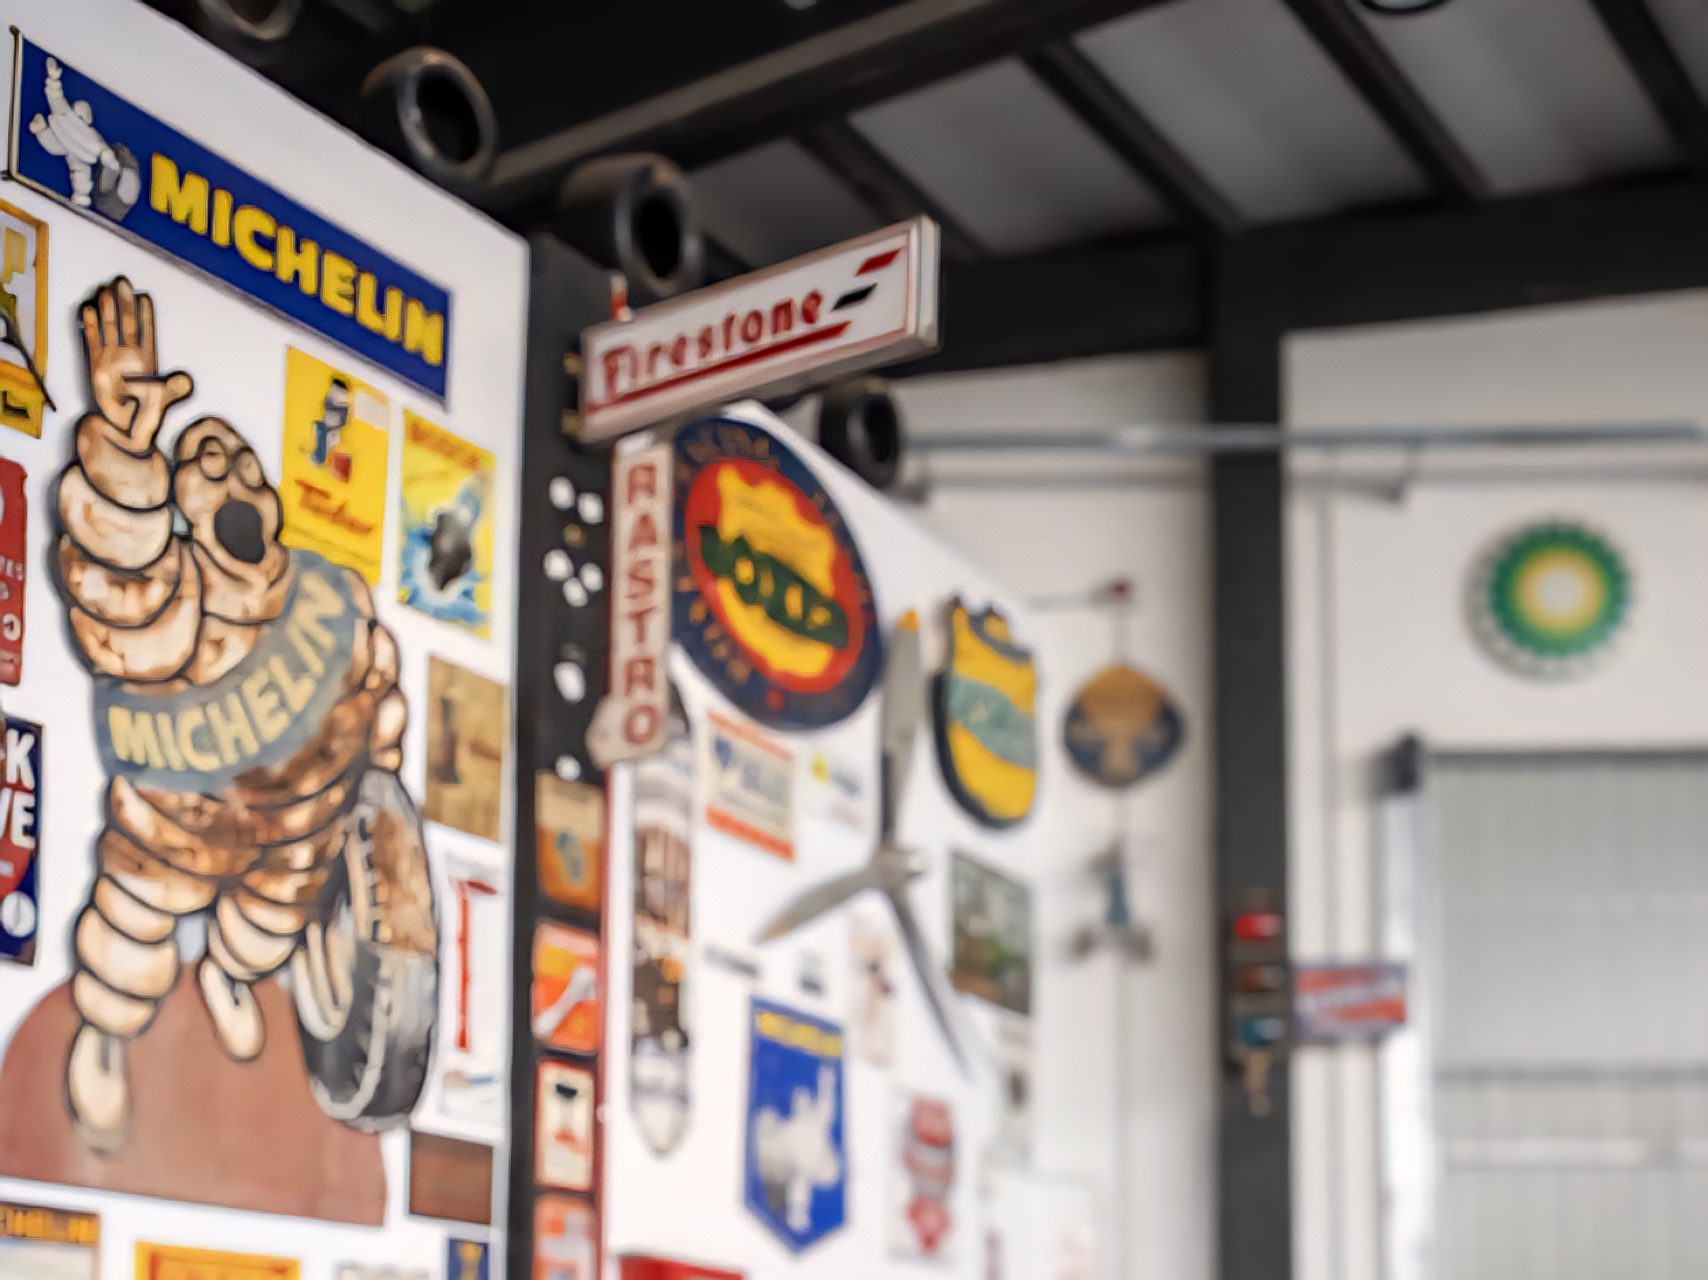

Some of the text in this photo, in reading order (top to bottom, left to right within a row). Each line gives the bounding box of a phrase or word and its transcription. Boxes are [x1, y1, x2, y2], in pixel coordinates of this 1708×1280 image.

[150, 152, 444, 366] MICHELIN
[603, 289, 824, 402] Firestone
[107, 570, 344, 772] MICHELIN
